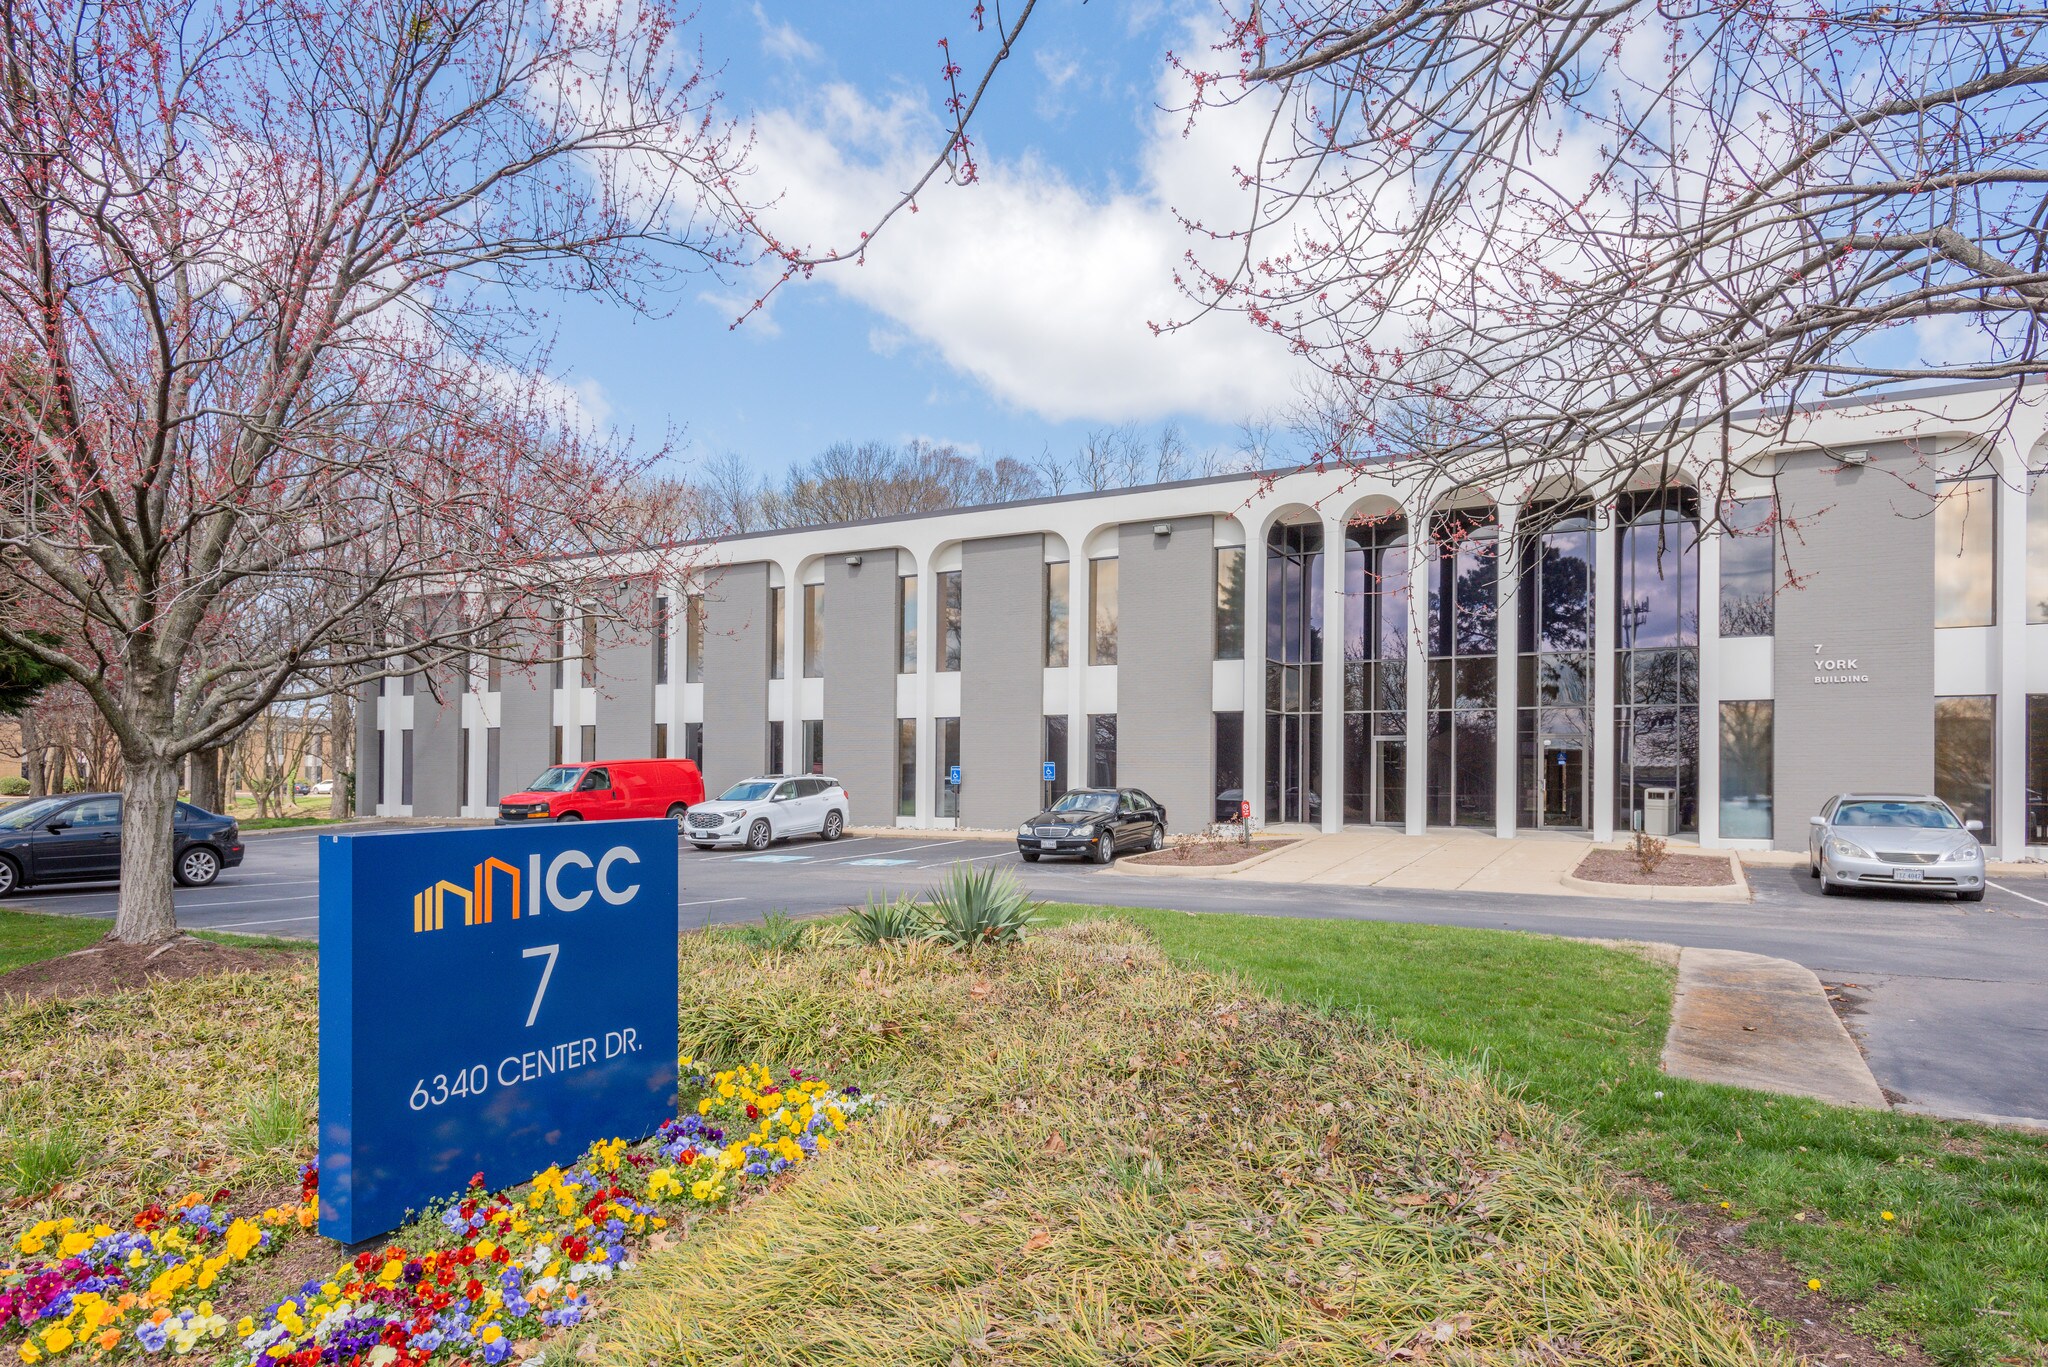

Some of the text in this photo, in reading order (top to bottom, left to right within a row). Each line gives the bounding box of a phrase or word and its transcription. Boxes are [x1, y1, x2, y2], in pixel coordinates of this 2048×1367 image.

[1814, 644, 1823, 654] 7
[1814, 659, 1858, 670] YORK
[1814, 675, 1869, 683] BUILDING
[528, 845, 640, 916] ICC
[522, 943, 560, 1028] 7
[409, 1027, 643, 1111] 6340 CENTER DR.
